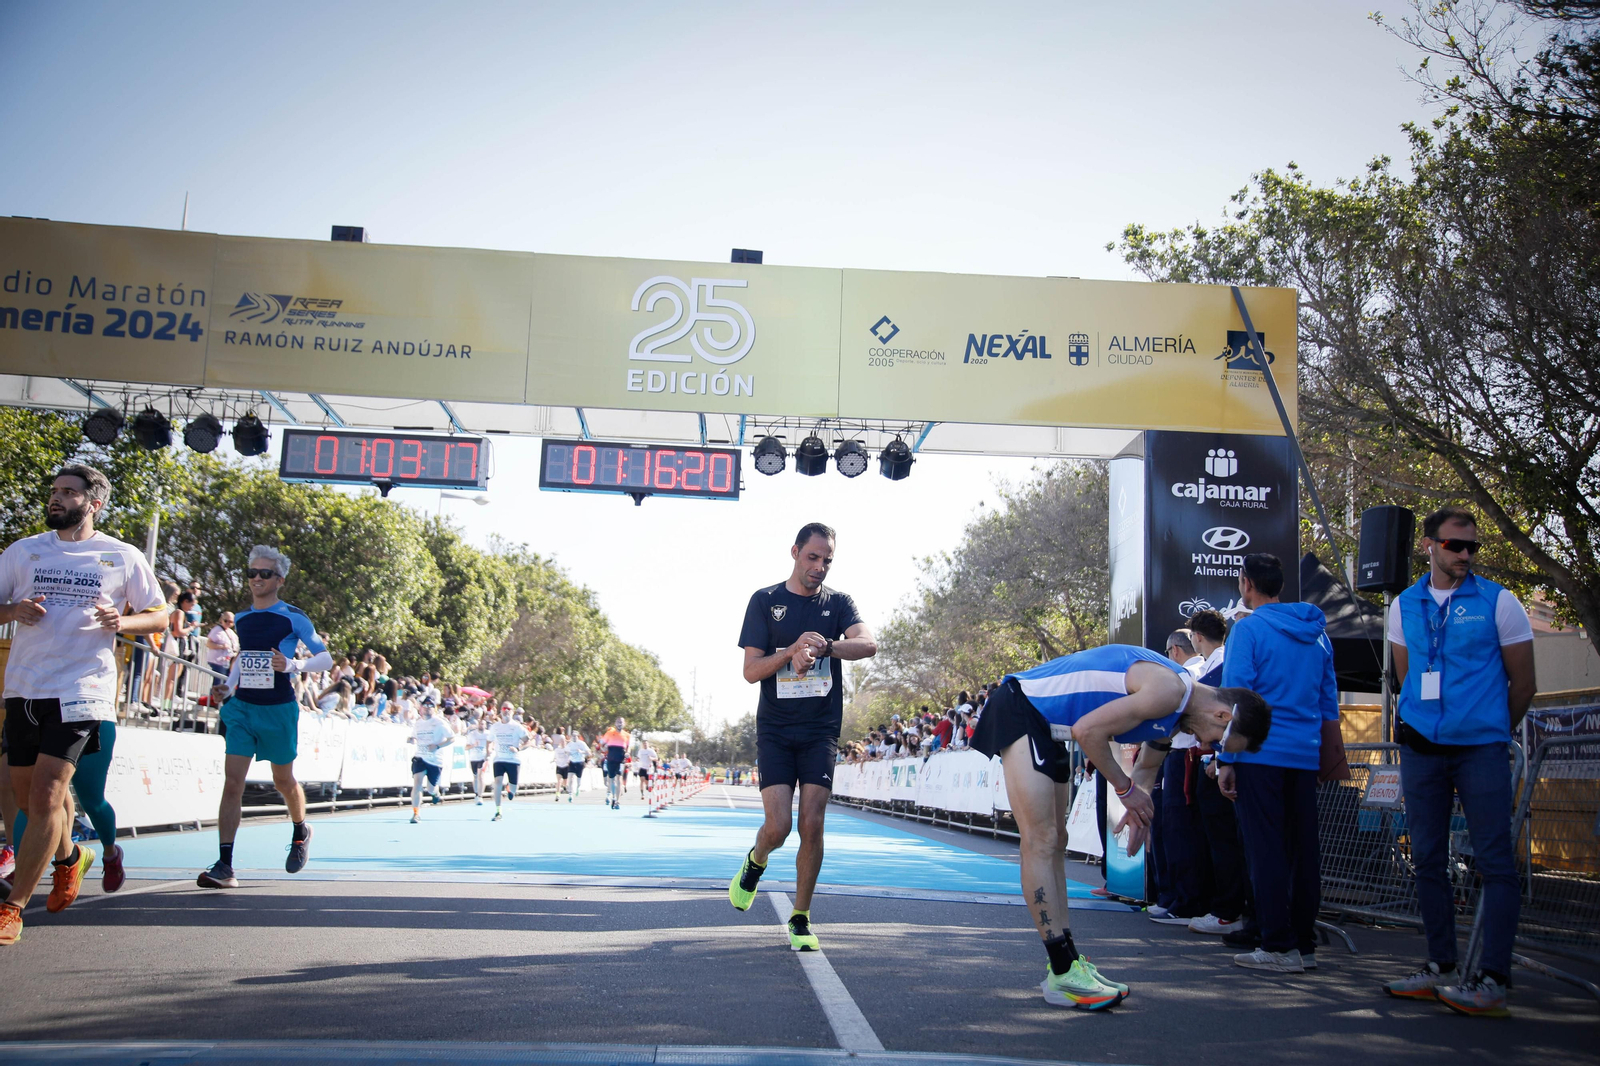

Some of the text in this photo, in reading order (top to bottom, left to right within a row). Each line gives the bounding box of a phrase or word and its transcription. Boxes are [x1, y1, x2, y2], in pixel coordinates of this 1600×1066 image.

[69, 275, 206, 307] Maratón
[292, 297, 343, 309] RFEA
[287, 308, 338, 319] SERIES
[102, 308, 204, 342] 2024
[282, 318, 366, 329] RUTA RUNNING
[628, 275, 757, 366] 25
[224, 330, 472, 359] RAMÓN RUIZ ANDÚJAR
[1108, 334, 1197, 354] ALMERÍA
[868, 347, 945, 361] COOPERACIÓN
[1108, 354, 1154, 366] CIUDAD
[868, 357, 895, 368] 2005
[626, 367, 755, 397] EDICIÓN
[1220, 374, 1257, 382] DEPORTES
[571, 445, 733, 493] 01:16:20
[1171, 478, 1272, 505] cajamar
[1219, 500, 1269, 509] CAJA RURAL
[1191, 552, 1245, 566] HYUND
[34, 568, 104, 580] Medio Maratón
[1194, 565, 1239, 577] Almeria
[33, 575, 102, 589] Almería 2024
[72, 587, 101, 596] ANDÚJAR
[1369, 788, 1398, 799] EVENTOS
